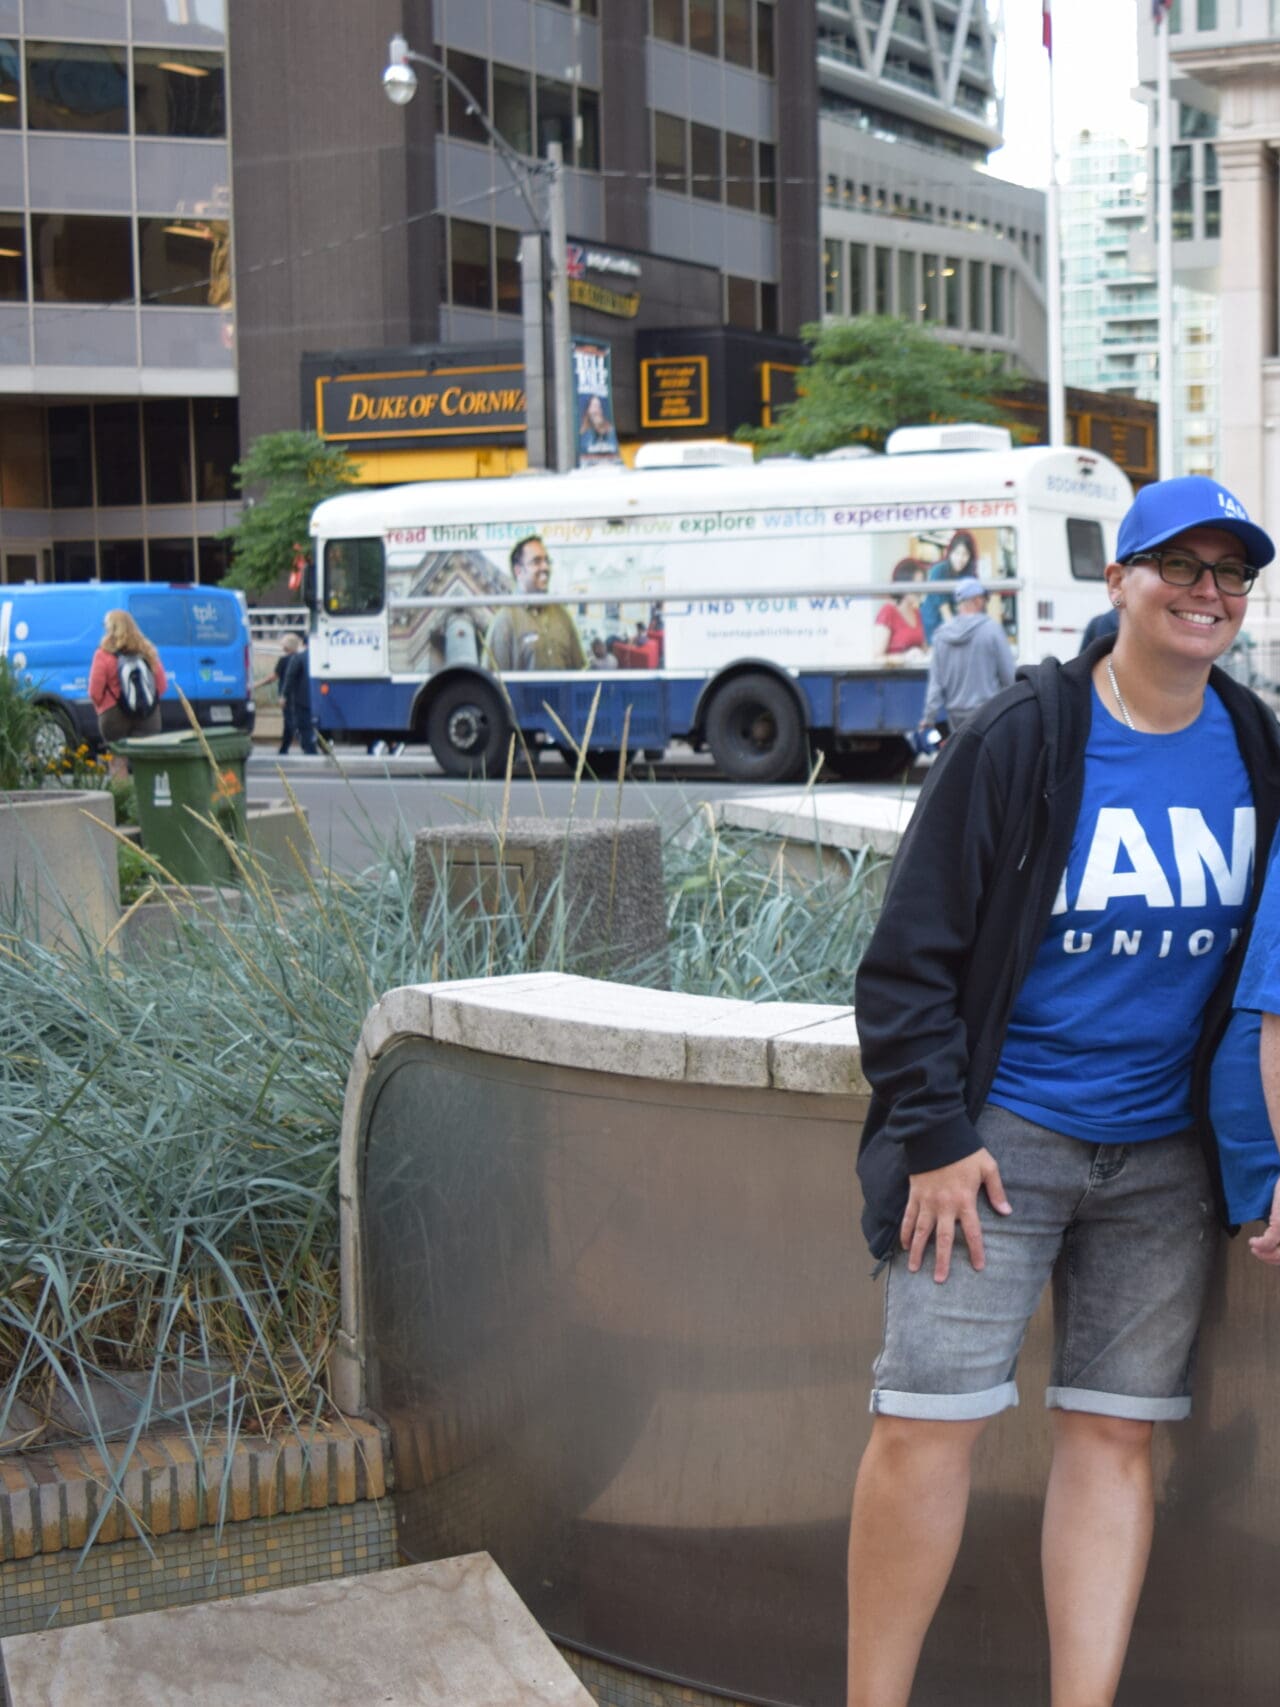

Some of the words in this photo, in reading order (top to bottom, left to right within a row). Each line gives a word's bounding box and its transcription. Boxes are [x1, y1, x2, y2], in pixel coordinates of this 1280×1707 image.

[347, 392, 409, 421] DUKE
[409, 393, 438, 418] OF
[440, 387, 527, 416] CORNWA
[386, 527, 426, 544] read
[432, 525, 478, 542] think
[486, 522, 536, 540] listen
[542, 520, 593, 542] enjoy
[679, 511, 756, 534] explore
[763, 508, 826, 529] watch
[834, 502, 951, 527] experience
[960, 500, 1017, 517] learn
[745, 599, 798, 612] YOUR
[810, 597, 852, 610] WAY
